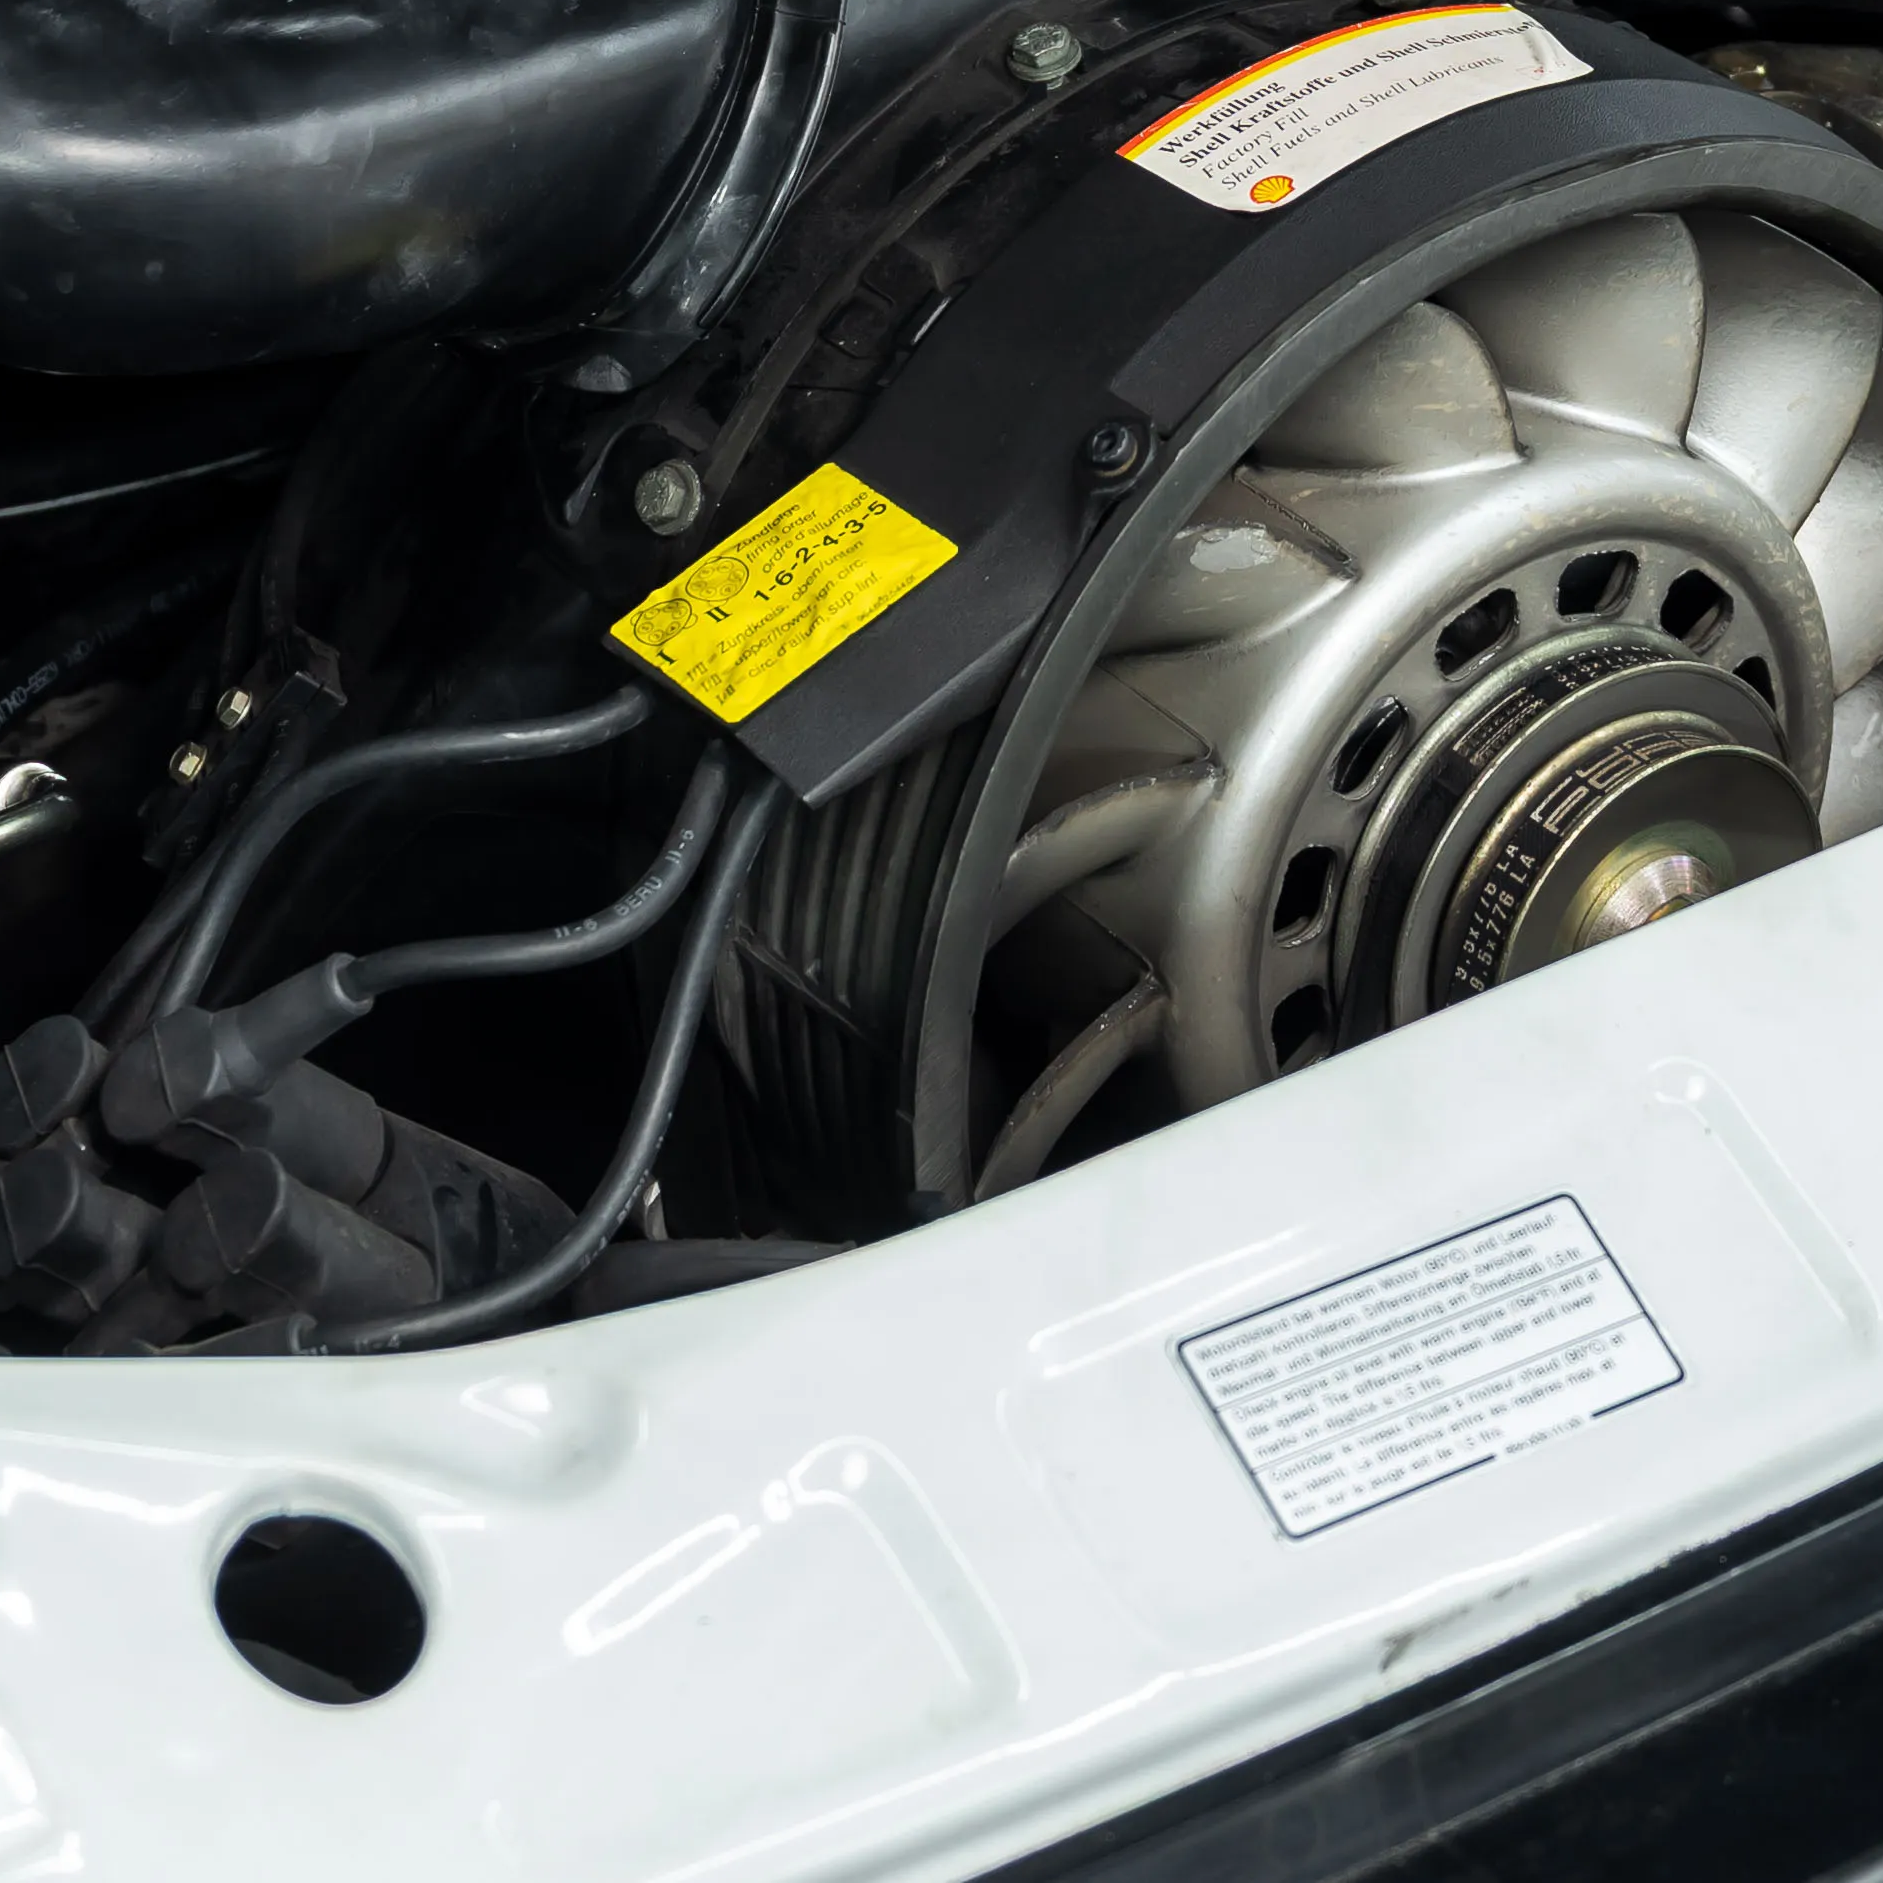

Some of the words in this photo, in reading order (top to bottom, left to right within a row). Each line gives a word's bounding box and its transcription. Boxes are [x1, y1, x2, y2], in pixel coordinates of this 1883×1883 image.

[1158, 82, 1285, 153] Werkfüllung
[1179, 132, 1230, 167] Shell
[1229, 76, 1336, 133] Kraftstoffe
[1339, 58, 1375, 77] und
[1376, 42, 1427, 59] Shell
[1221, 154, 1267, 187] Shell
[1269, 127, 1320, 157] Fuels
[1325, 103, 1358, 126] and
[1358, 82, 1406, 105] Shell
[1408, 57, 1503, 87] Lubricants
[1202, 133, 1271, 178] Factory
[1274, 107, 1308, 130] Fill
[745, 534, 780, 563] firing
[777, 509, 816, 534] order
[753, 500, 886, 600] 1-6-2-4-3-5
[762, 539, 803, 573] ordre
[656, 649, 676, 664] I
[705, 606, 731, 622] II
[610, 870, 666, 921] BERU
[1509, 853, 1537, 885] LA
